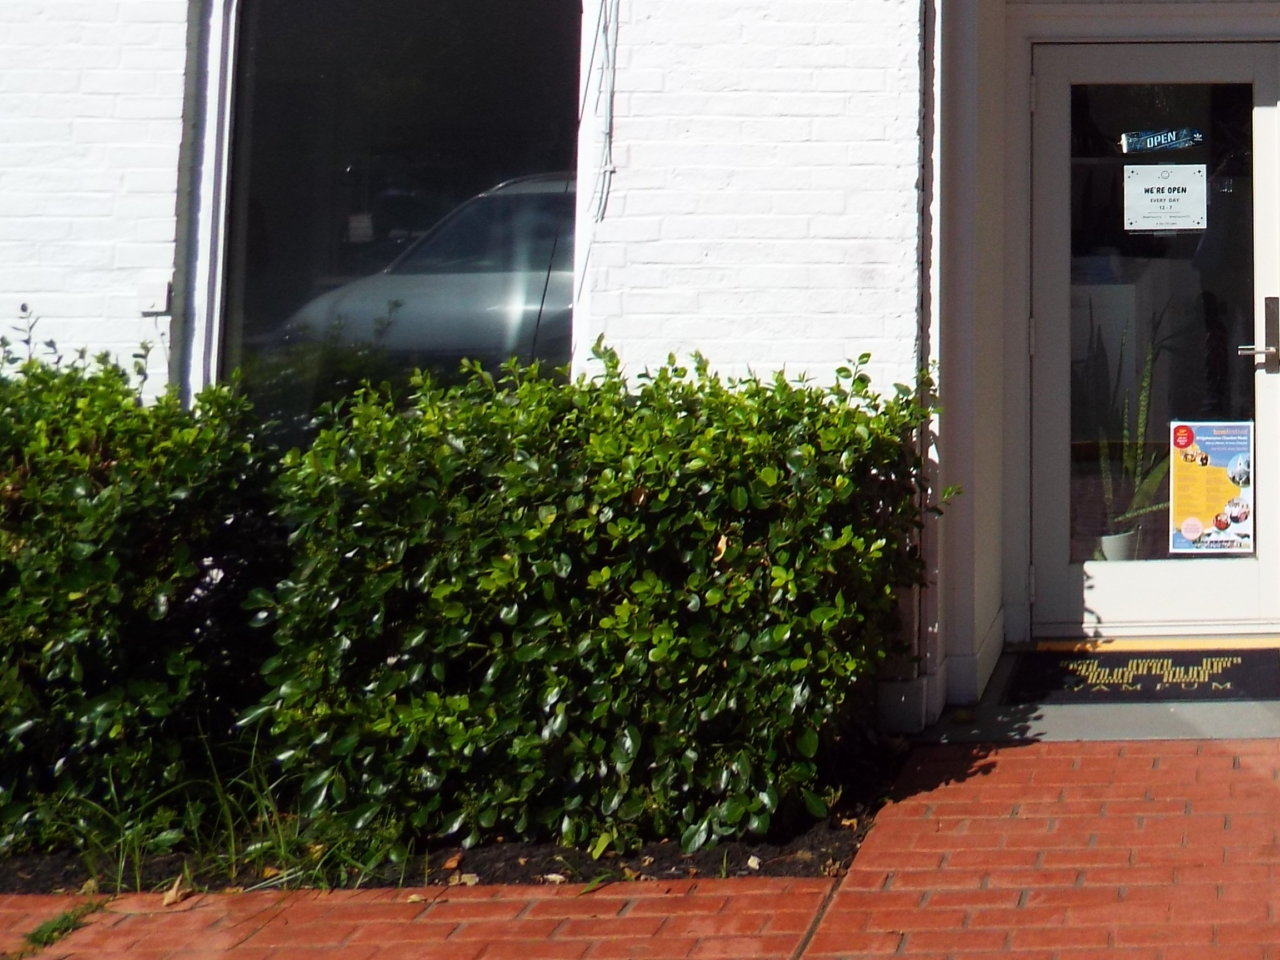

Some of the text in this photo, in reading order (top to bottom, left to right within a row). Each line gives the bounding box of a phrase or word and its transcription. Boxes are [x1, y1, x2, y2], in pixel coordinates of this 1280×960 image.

[1147, 131, 1176, 148] OPEN
[1144, 186, 1187, 194] WE'RE OPEN
